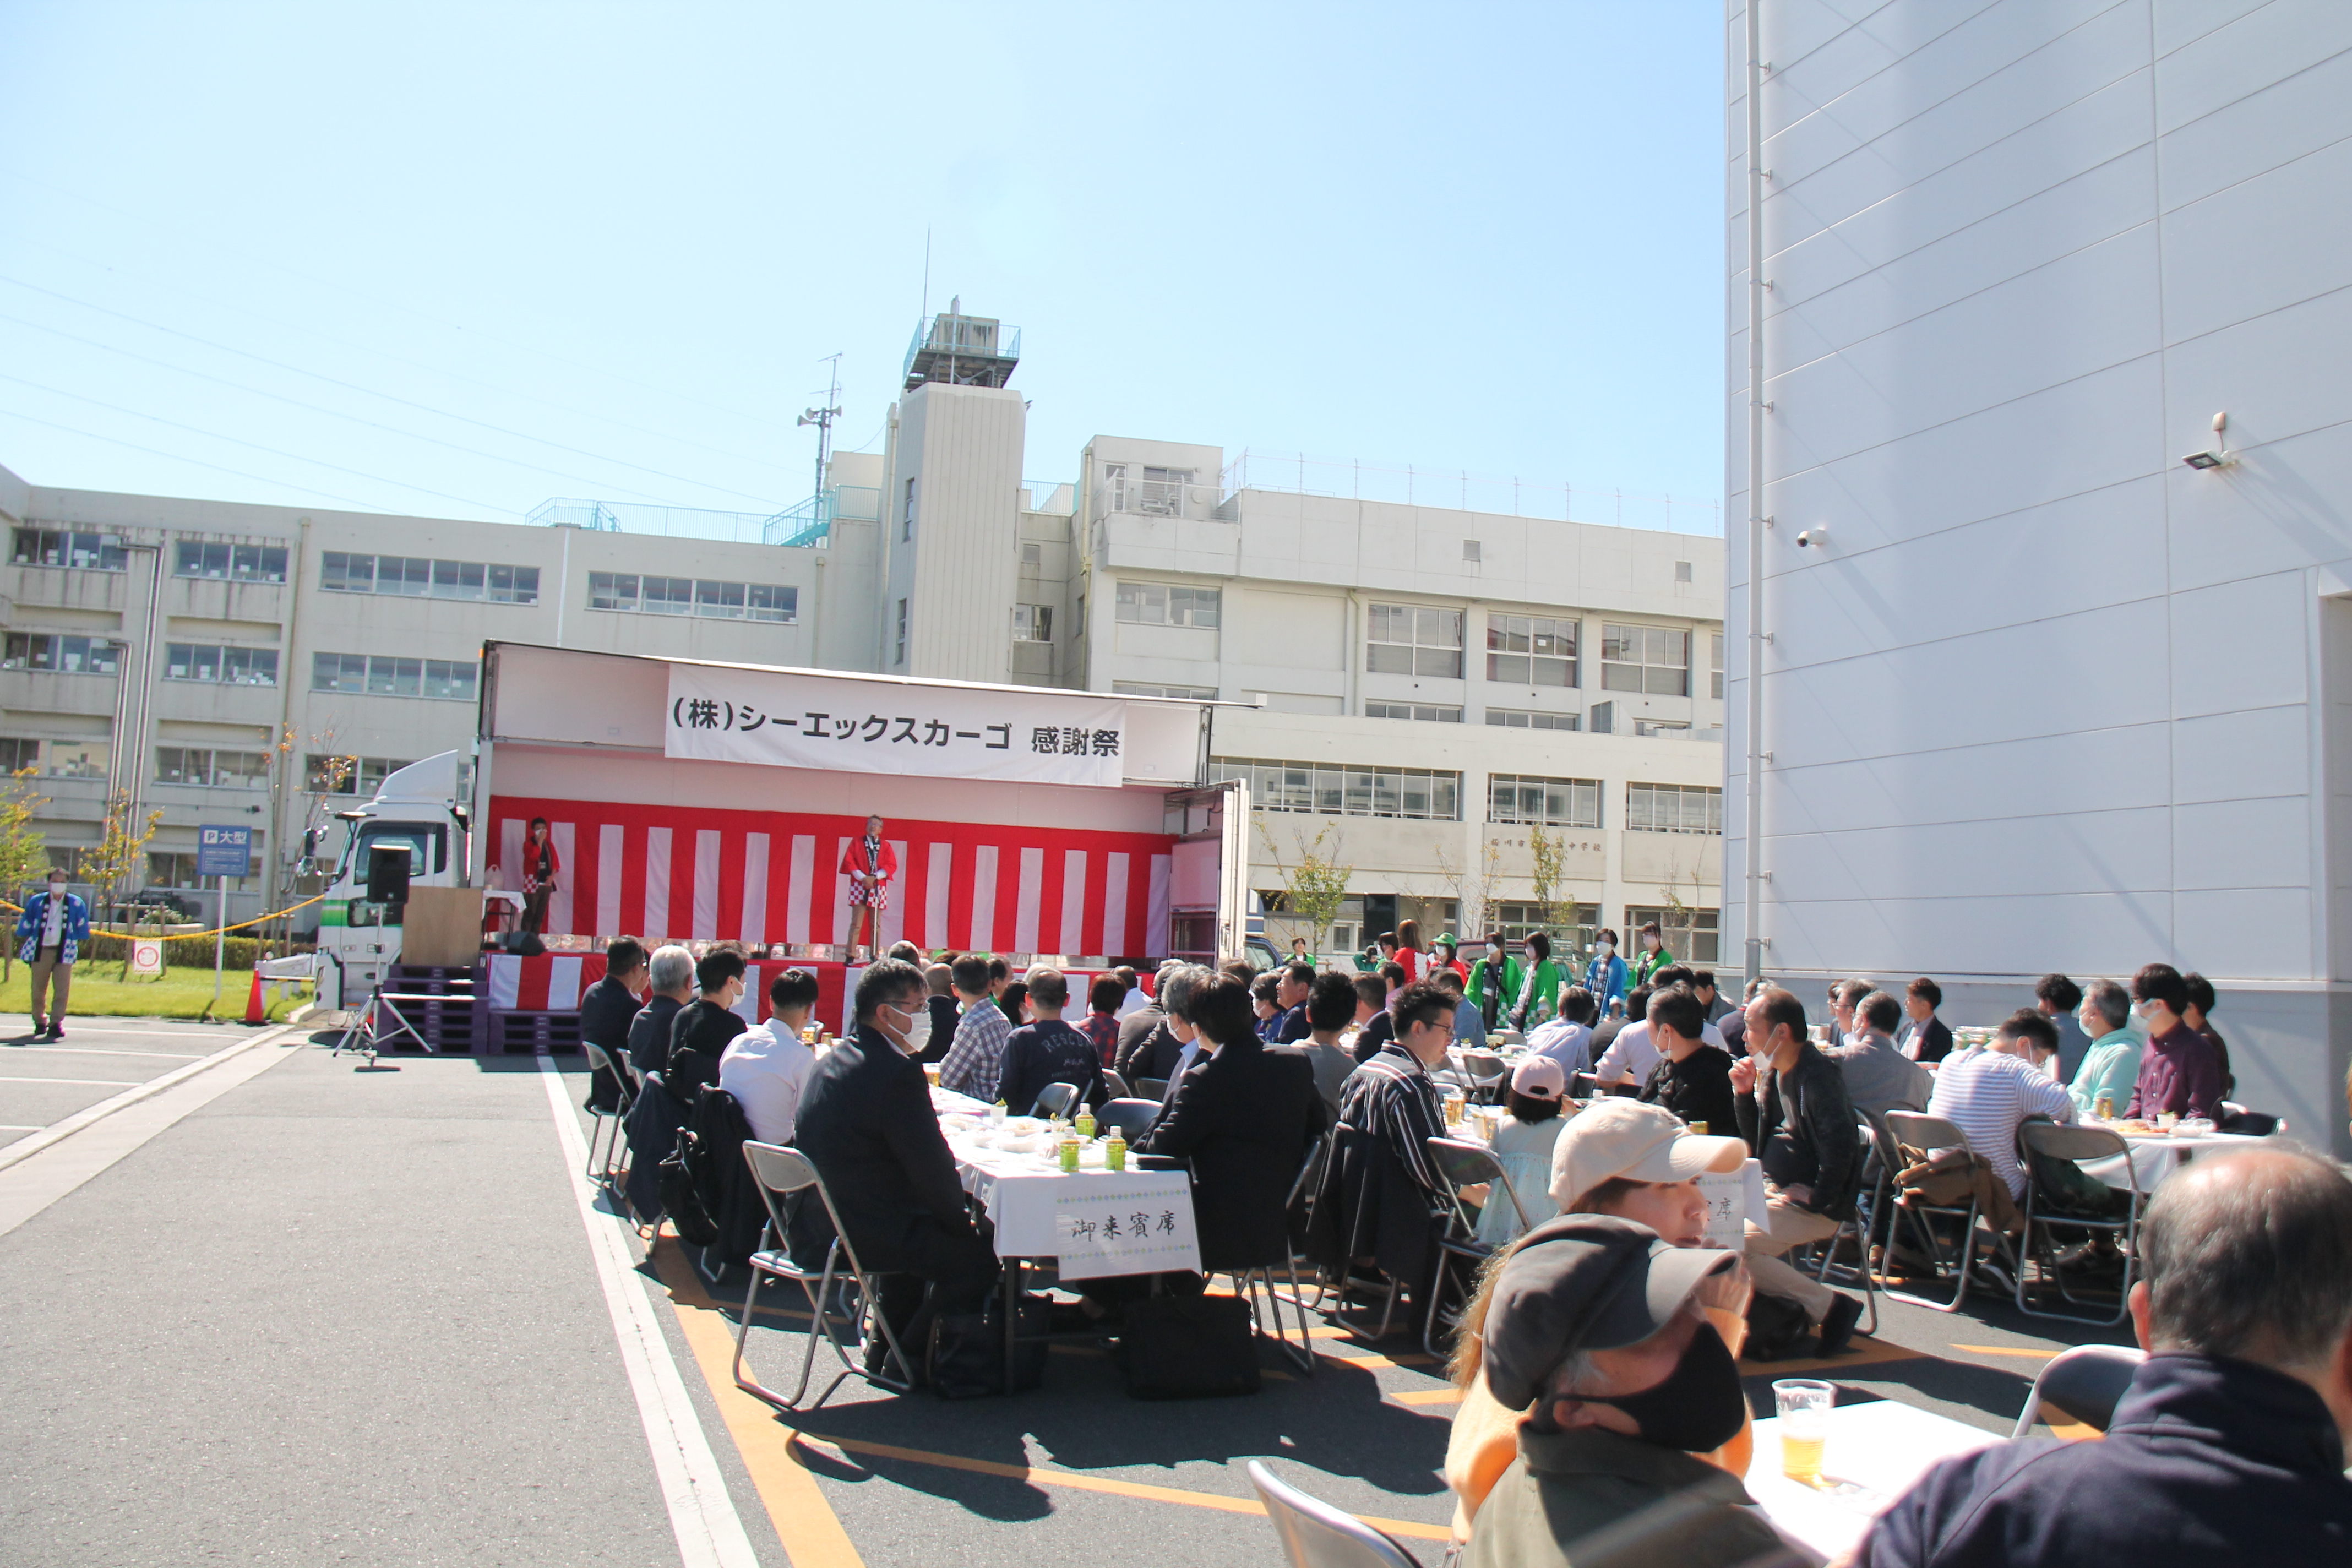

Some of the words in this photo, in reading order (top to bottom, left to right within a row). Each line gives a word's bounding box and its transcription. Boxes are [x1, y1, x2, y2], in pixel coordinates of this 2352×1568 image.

[673, 697, 1012, 749] (株)シーエックスカーゴ
[1031, 726, 1119, 757] 感謝祭
[220, 830, 247, 844] 大型
[1070, 1210, 1175, 1242] 御来賓席
